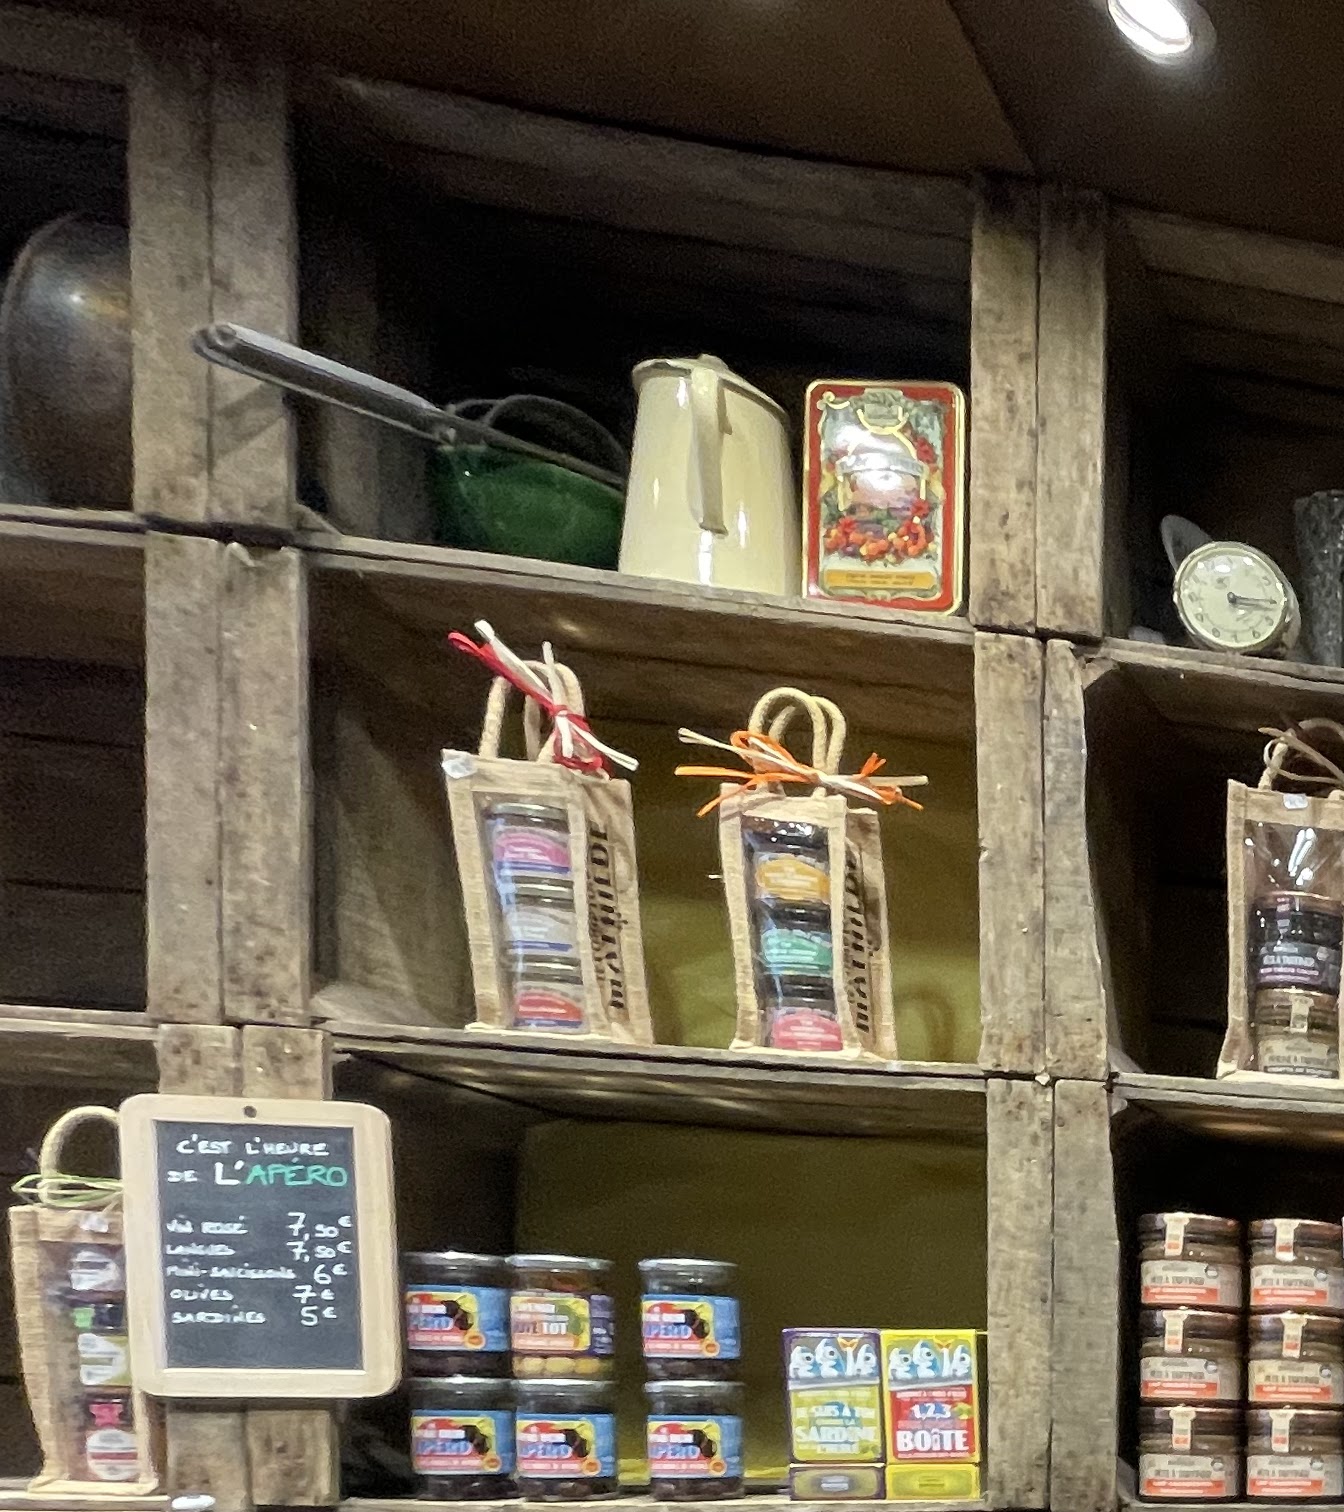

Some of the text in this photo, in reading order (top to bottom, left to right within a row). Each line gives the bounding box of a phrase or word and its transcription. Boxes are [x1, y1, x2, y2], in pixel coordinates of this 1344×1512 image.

[175, 1133, 330, 1156] C'EST L'HEURE
[167, 1169, 198, 1182] DE
